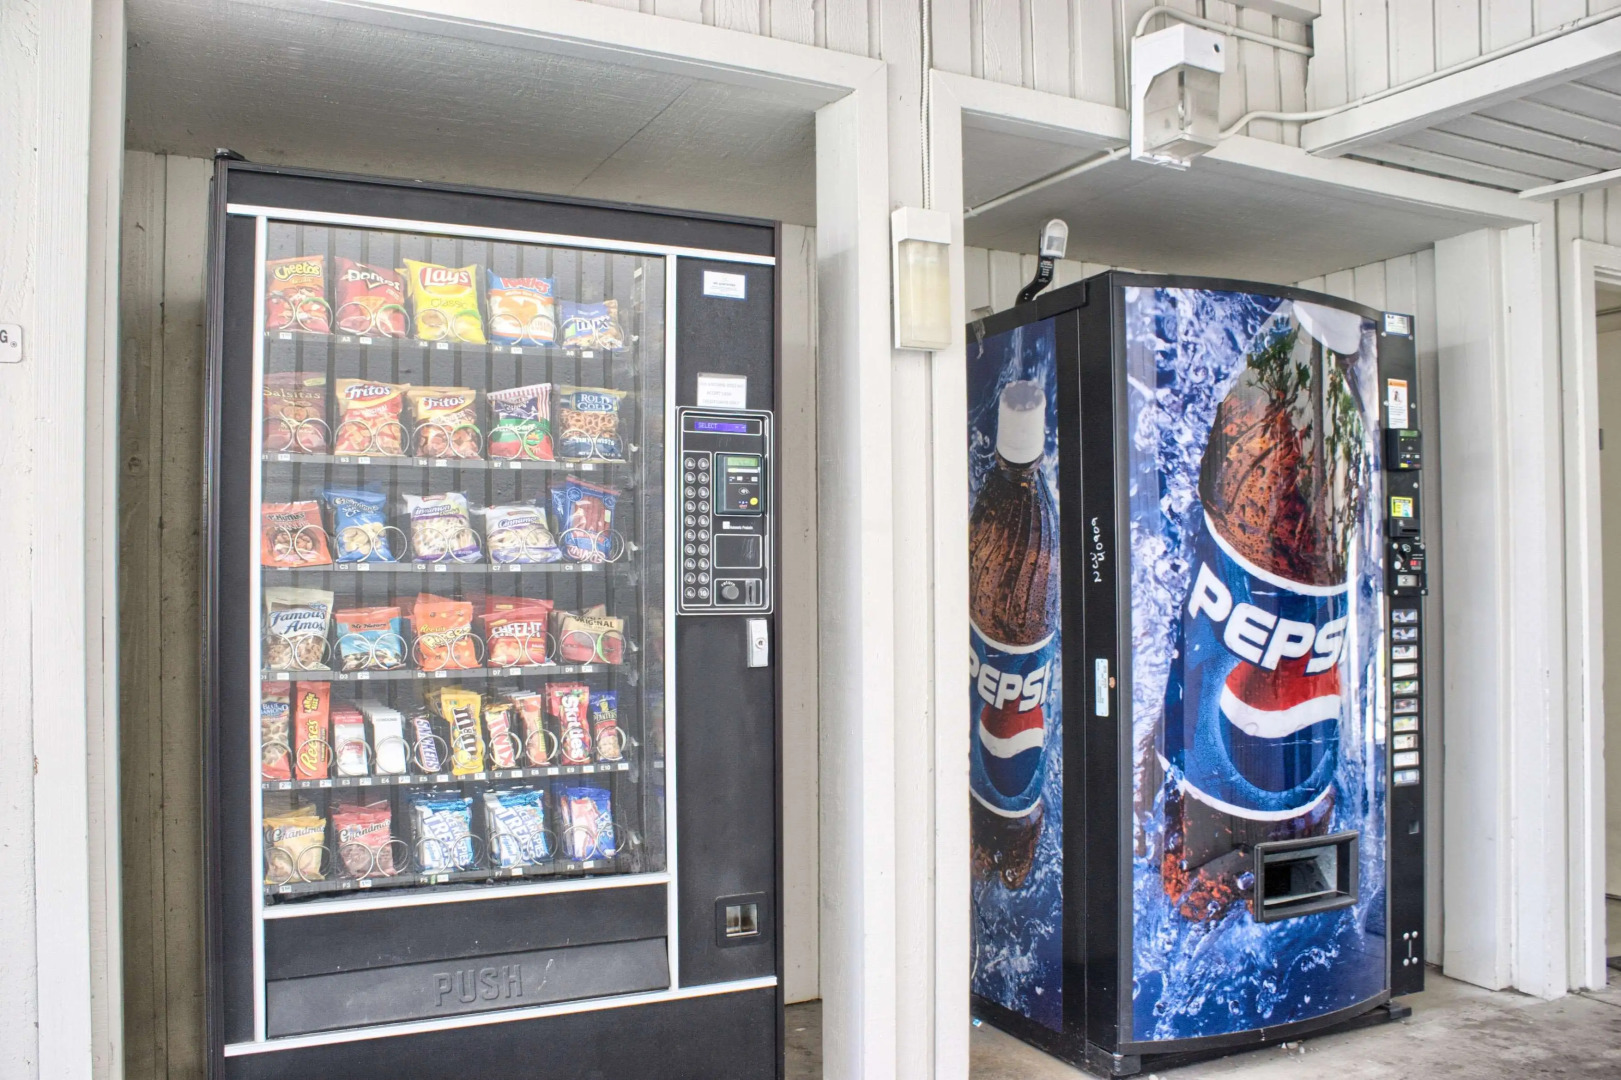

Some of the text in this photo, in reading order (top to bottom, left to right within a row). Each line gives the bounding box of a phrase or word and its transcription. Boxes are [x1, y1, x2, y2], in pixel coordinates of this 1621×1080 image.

[275, 263, 320, 281] Cheetos
[347, 269, 400, 291] Doritos
[264, 387, 320, 399] Salsitas
[345, 384, 391, 400] Fritos
[581, 393, 610, 404] ROLD
[423, 396, 465, 410] Fritos
[577, 402, 612, 411] GOLD
[270, 610, 325, 627] Famous
[1188, 561, 1348, 674] PEPSI
[283, 620, 325, 634] Amos
[491, 621, 543, 638] CHEEZ-IT
[300, 719, 319, 771] Reese's
[416, 718, 440, 769] SNICKERS
[433, 964, 523, 1007] PUSH
